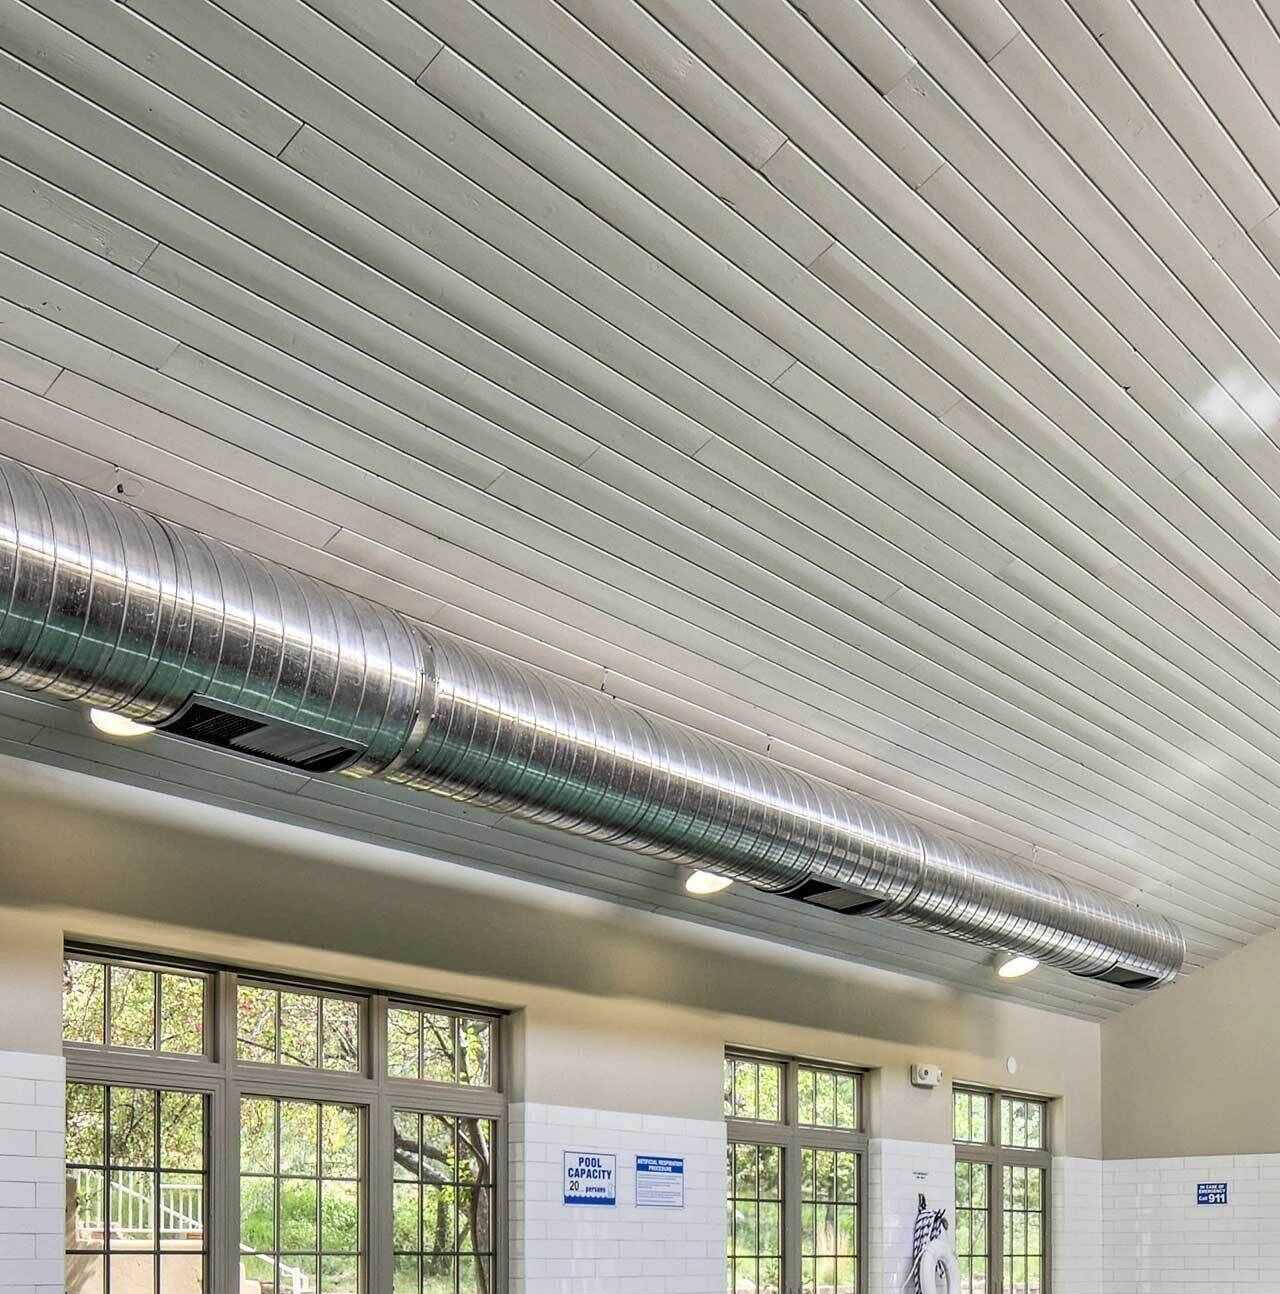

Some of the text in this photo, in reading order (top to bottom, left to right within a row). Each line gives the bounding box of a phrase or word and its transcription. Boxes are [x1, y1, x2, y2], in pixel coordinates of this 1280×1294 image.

[578, 1156, 602, 1168] POOL
[568, 1167, 612, 1180] CAPACITY
[569, 1180, 580, 1191] 20
[1209, 1194, 1225, 1203] 911
